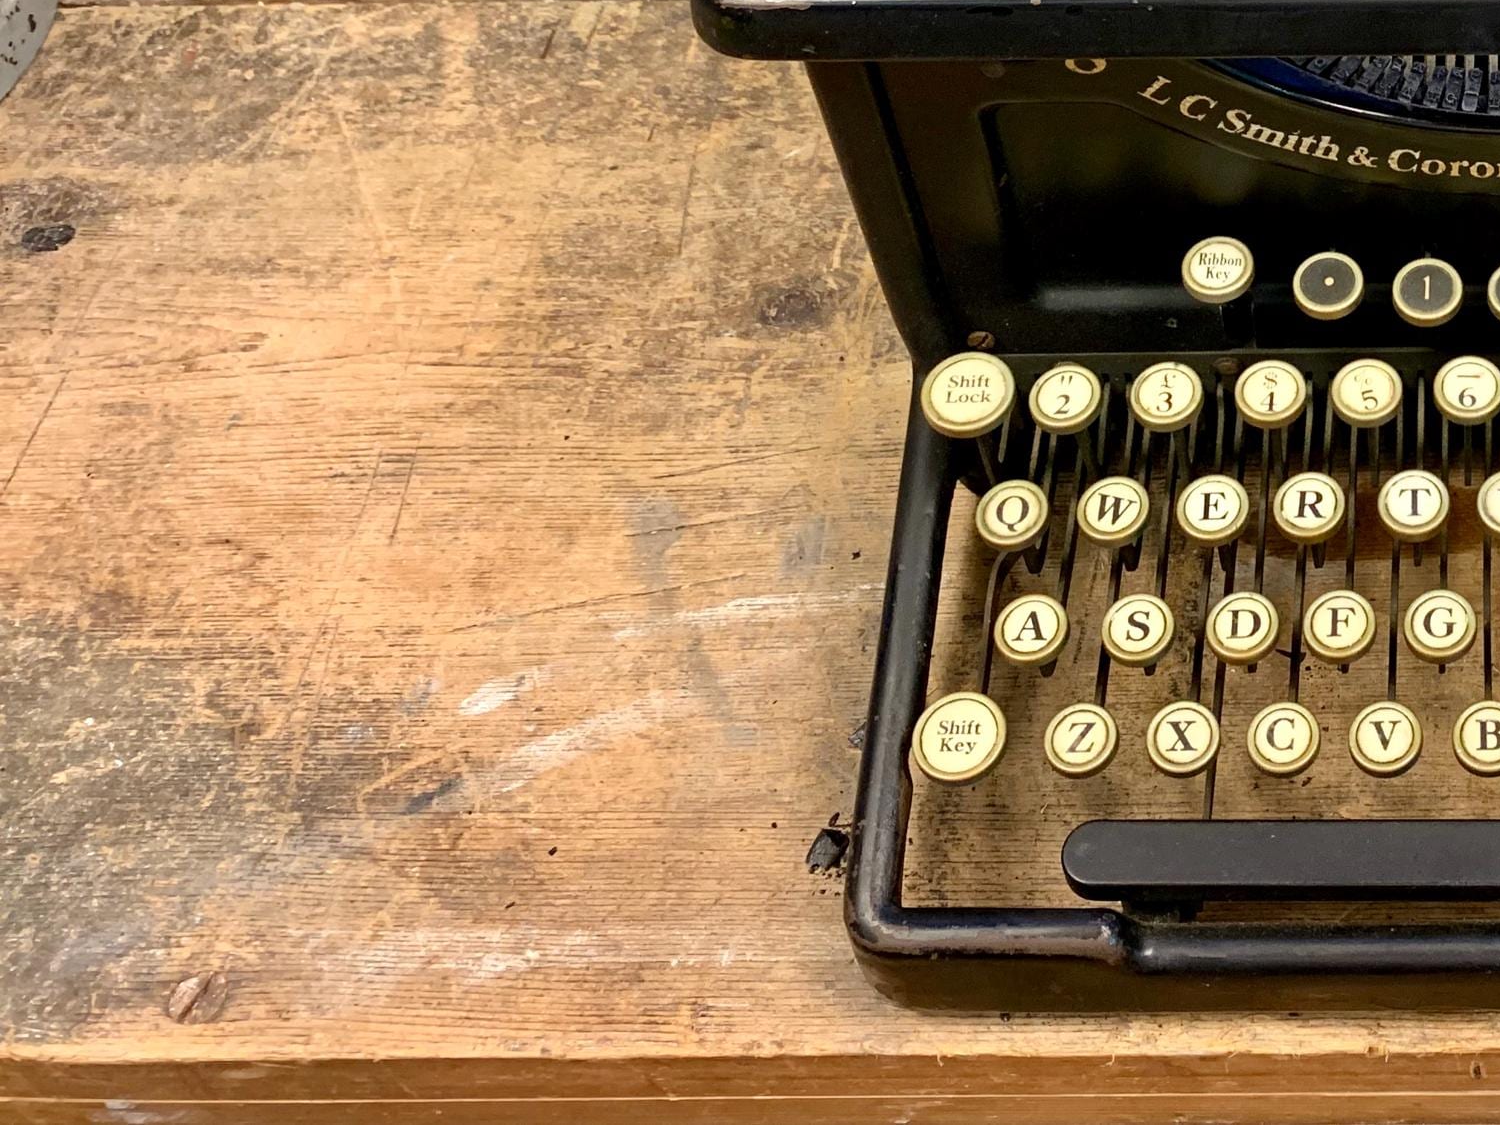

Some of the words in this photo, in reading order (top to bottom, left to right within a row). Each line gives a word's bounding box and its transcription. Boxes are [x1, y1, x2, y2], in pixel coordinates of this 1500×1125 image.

[1137, 75, 1172, 105] L
[1179, 94, 1218, 121] C
[1217, 108, 1340, 163] Smith
[1347, 146, 1379, 168] &
[1199, 252, 1242, 268] Ribbon
[1205, 267, 1231, 283] Key
[1422, 275, 1431, 301] 1
[947, 373, 990, 389] Shift
[945, 390, 991, 405] Lock
[1053, 394, 1072, 415] 2
[1156, 391, 1174, 413] 3
[1260, 391, 1278, 413] 4
[1361, 389, 1379, 411] 5
[1458, 387, 1477, 409] 6
[996, 495, 1029, 532] Q
[1096, 492, 1137, 524] W
[1199, 491, 1229, 522] E
[1293, 490, 1327, 520] R
[1399, 487, 1432, 517] T
[1012, 610, 1047, 642] A
[1125, 610, 1151, 641] S
[1226, 608, 1262, 640] D
[1326, 606, 1357, 638] F
[1422, 607, 1457, 638] G
[937, 720, 981, 736] Shift
[1066, 722, 1097, 754] Z
[1165, 720, 1198, 752] X
[1265, 717, 1295, 751] C
[1369, 720, 1402, 751] V
[939, 737, 977, 755] Key
